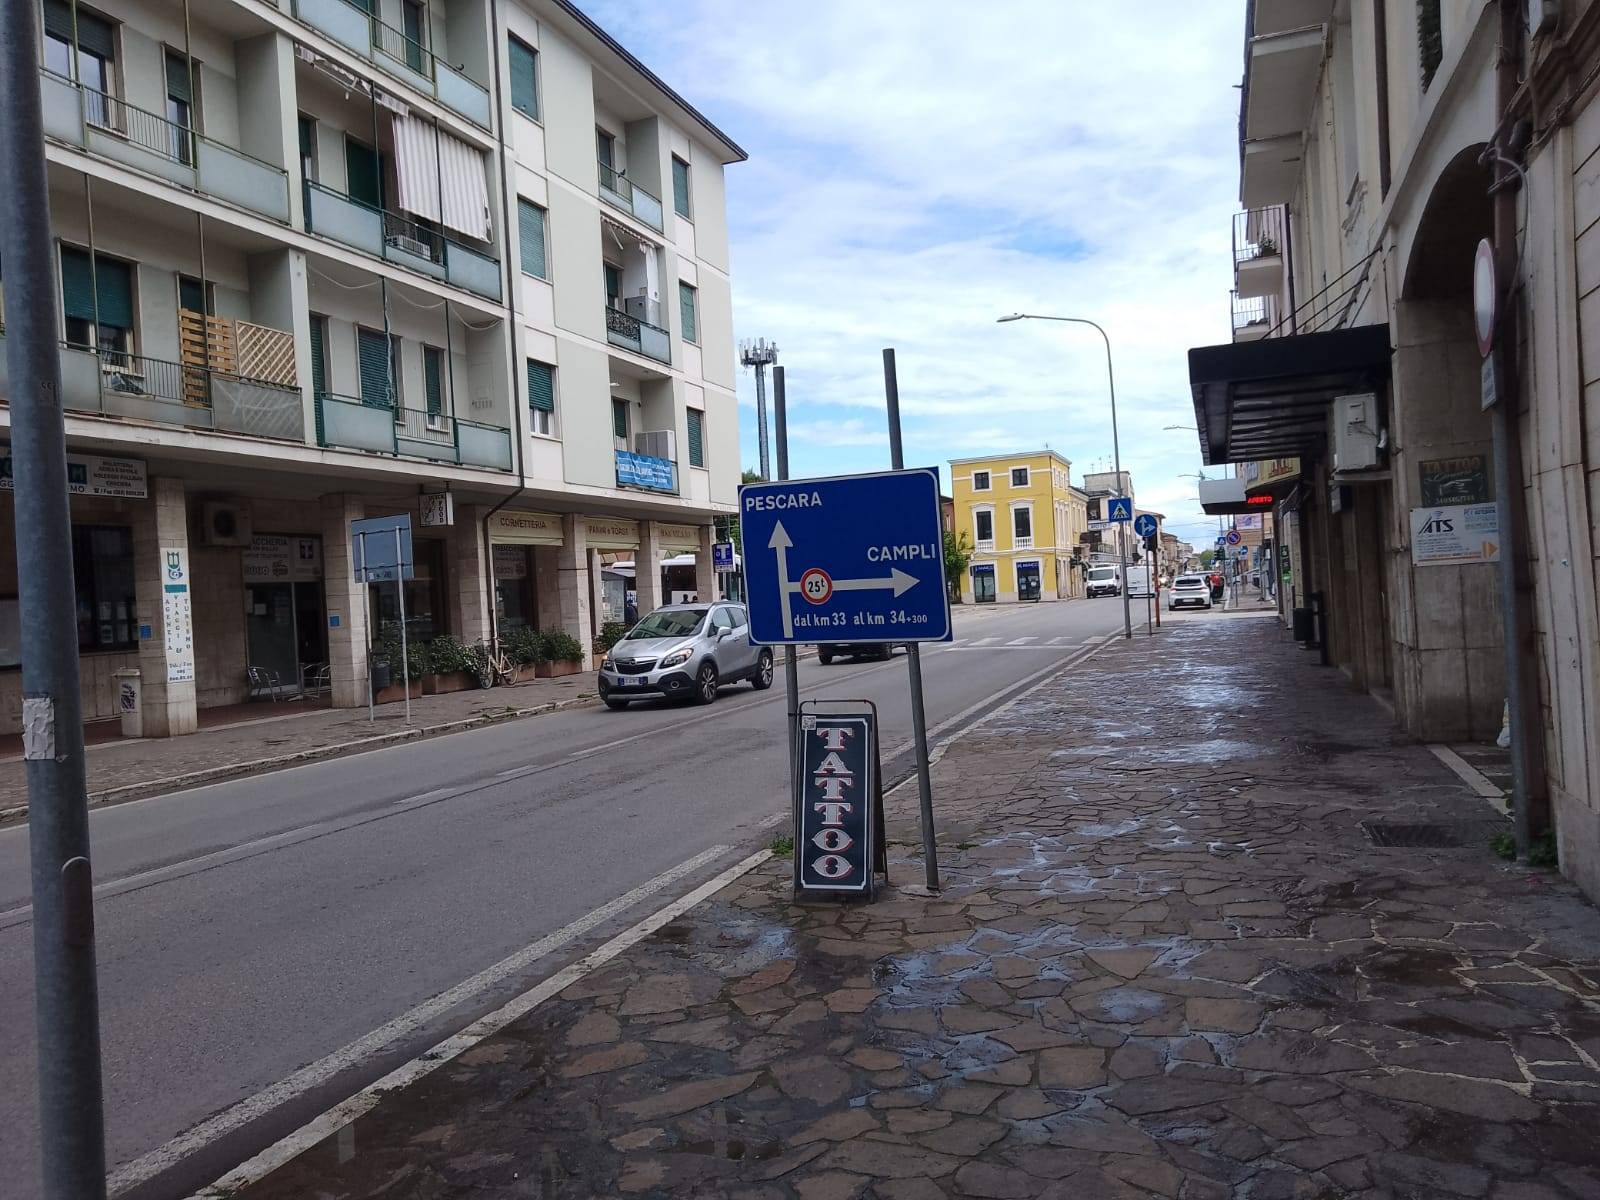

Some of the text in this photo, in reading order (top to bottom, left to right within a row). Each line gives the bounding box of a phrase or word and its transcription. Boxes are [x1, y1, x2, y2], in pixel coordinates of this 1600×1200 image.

[745, 492, 823, 512] PESCARA
[500, 518, 546, 529] CORNETTERIA
[867, 544, 936, 562] CAMPLI
[165, 599, 173, 651] AGENZIA
[183, 598, 191, 650] TURISMO
[794, 614, 811, 627] dal
[832, 612, 846, 625] 33
[853, 614, 864, 625] al
[867, 614, 885, 625] km
[811, 727, 855, 879] TATTOO
